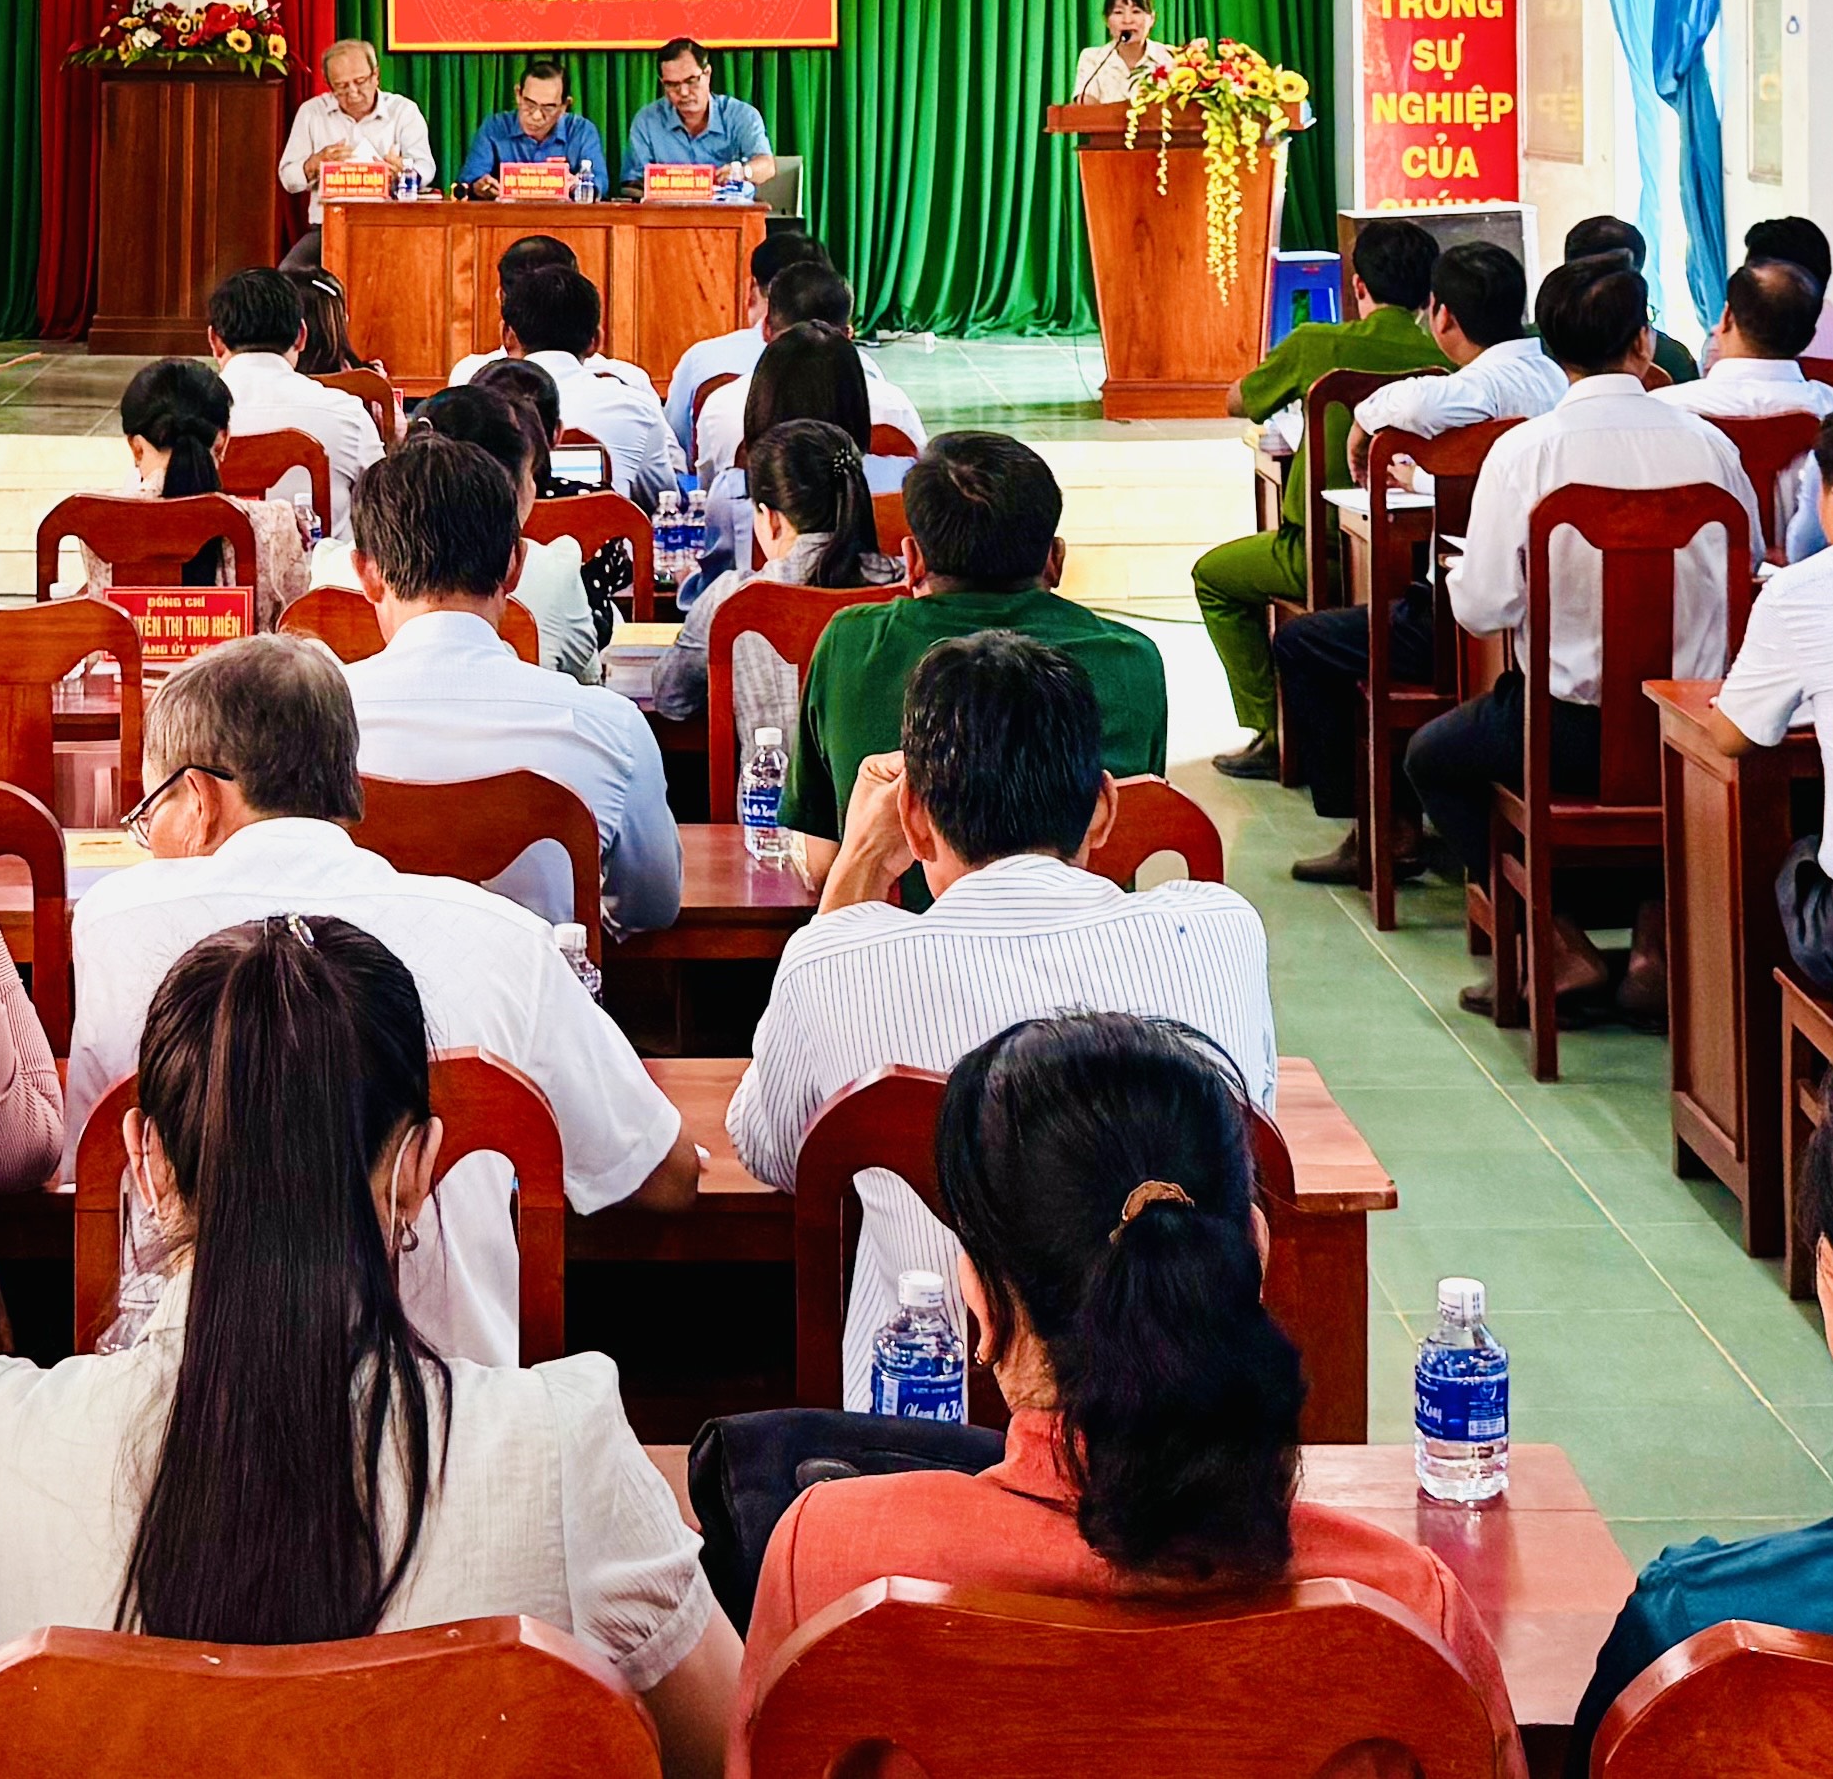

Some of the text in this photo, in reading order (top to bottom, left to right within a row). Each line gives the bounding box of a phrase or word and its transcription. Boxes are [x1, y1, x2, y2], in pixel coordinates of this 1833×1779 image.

[1412, 32, 1465, 81] SỰ
[1371, 85, 1514, 132] NGHIỆP
[1401, 134, 1480, 179] CỦA
[164, 615, 183, 641] THỊ
[185, 616, 209, 637] THU
